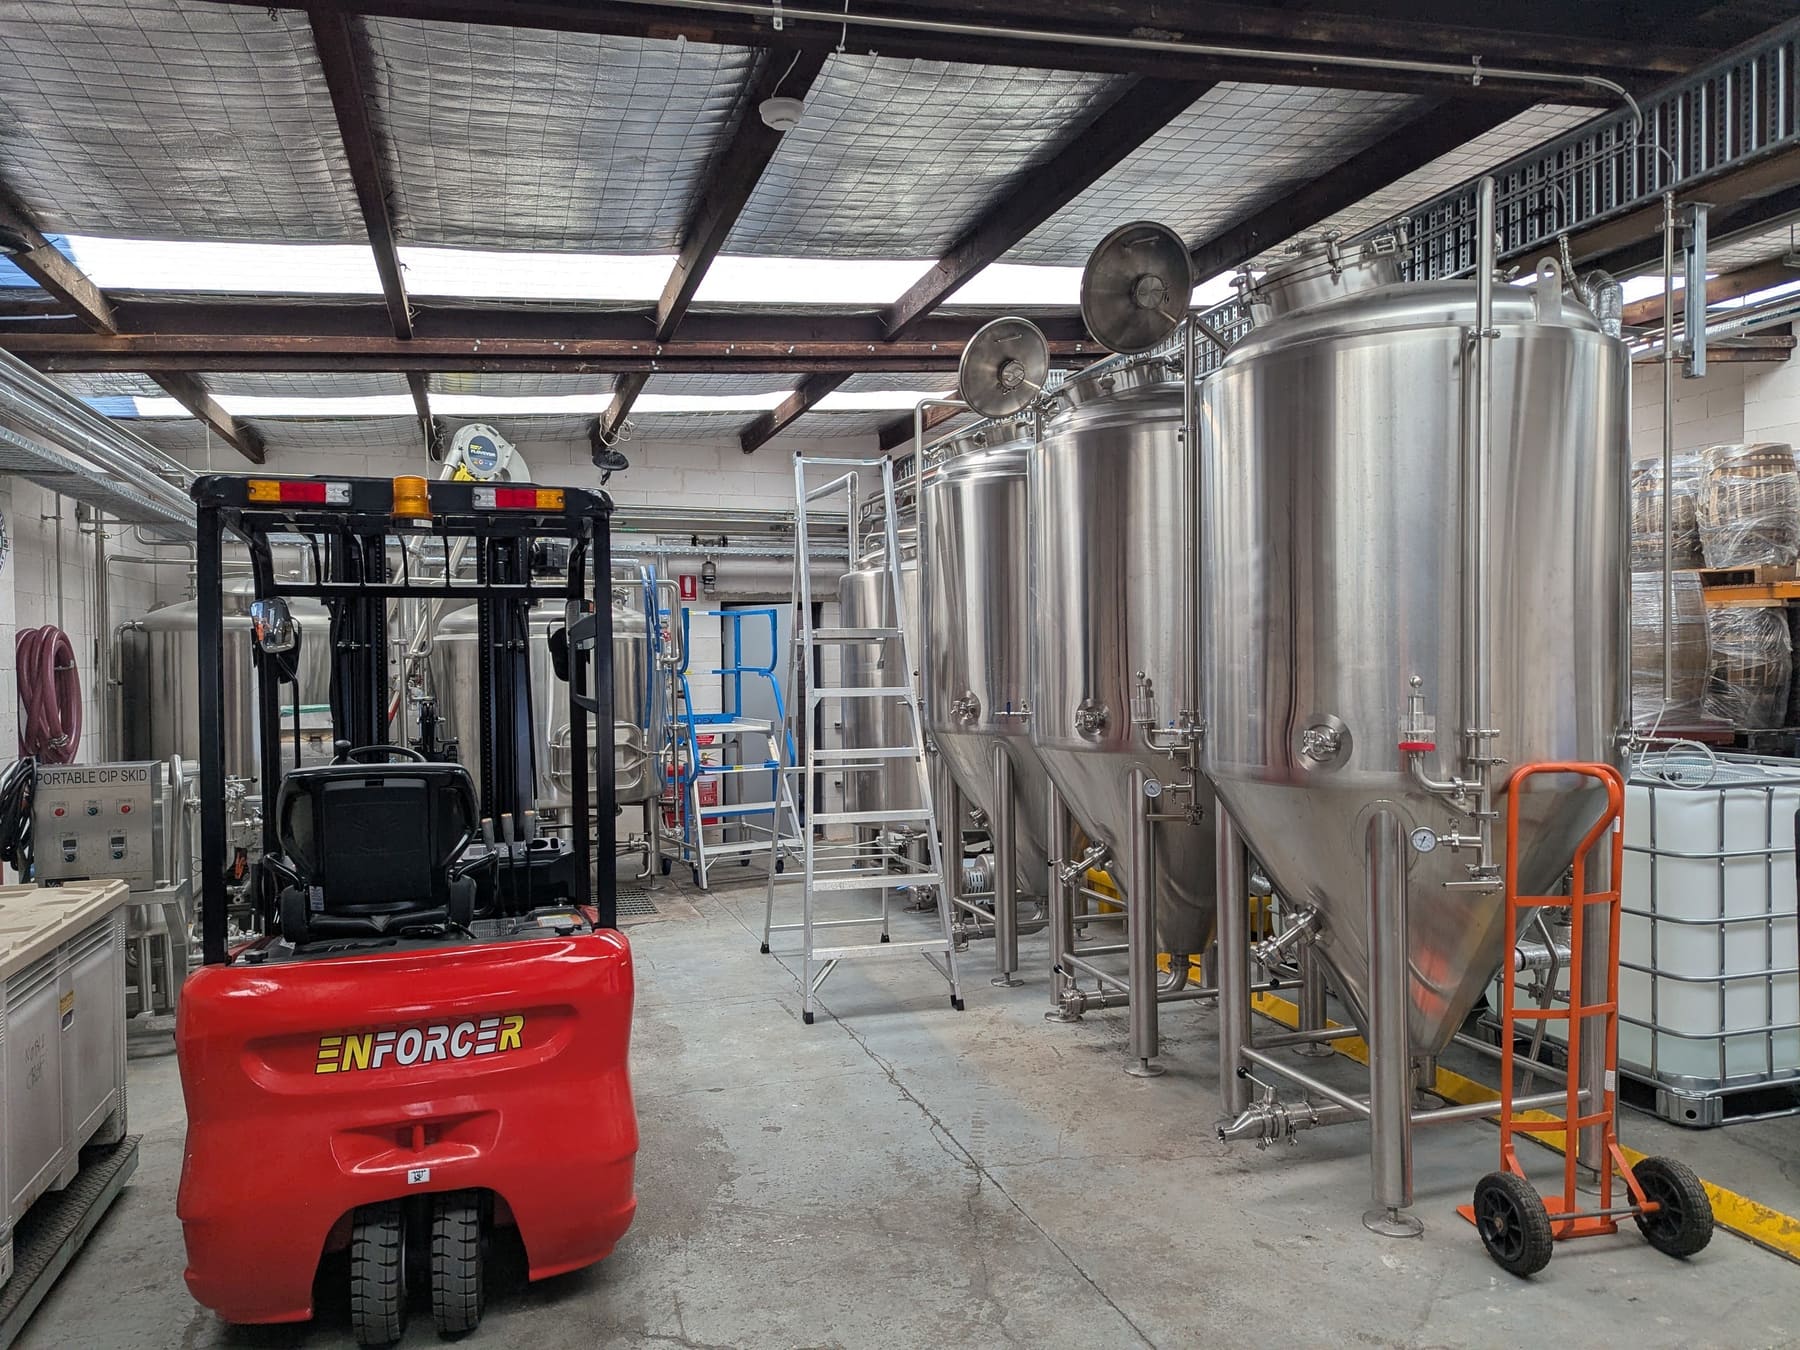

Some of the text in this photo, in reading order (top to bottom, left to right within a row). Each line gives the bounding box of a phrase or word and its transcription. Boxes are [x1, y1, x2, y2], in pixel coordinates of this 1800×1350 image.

[36, 769, 147, 785] PORTABLE CIP SKID
[315, 1015, 524, 1075] ENFORCER
